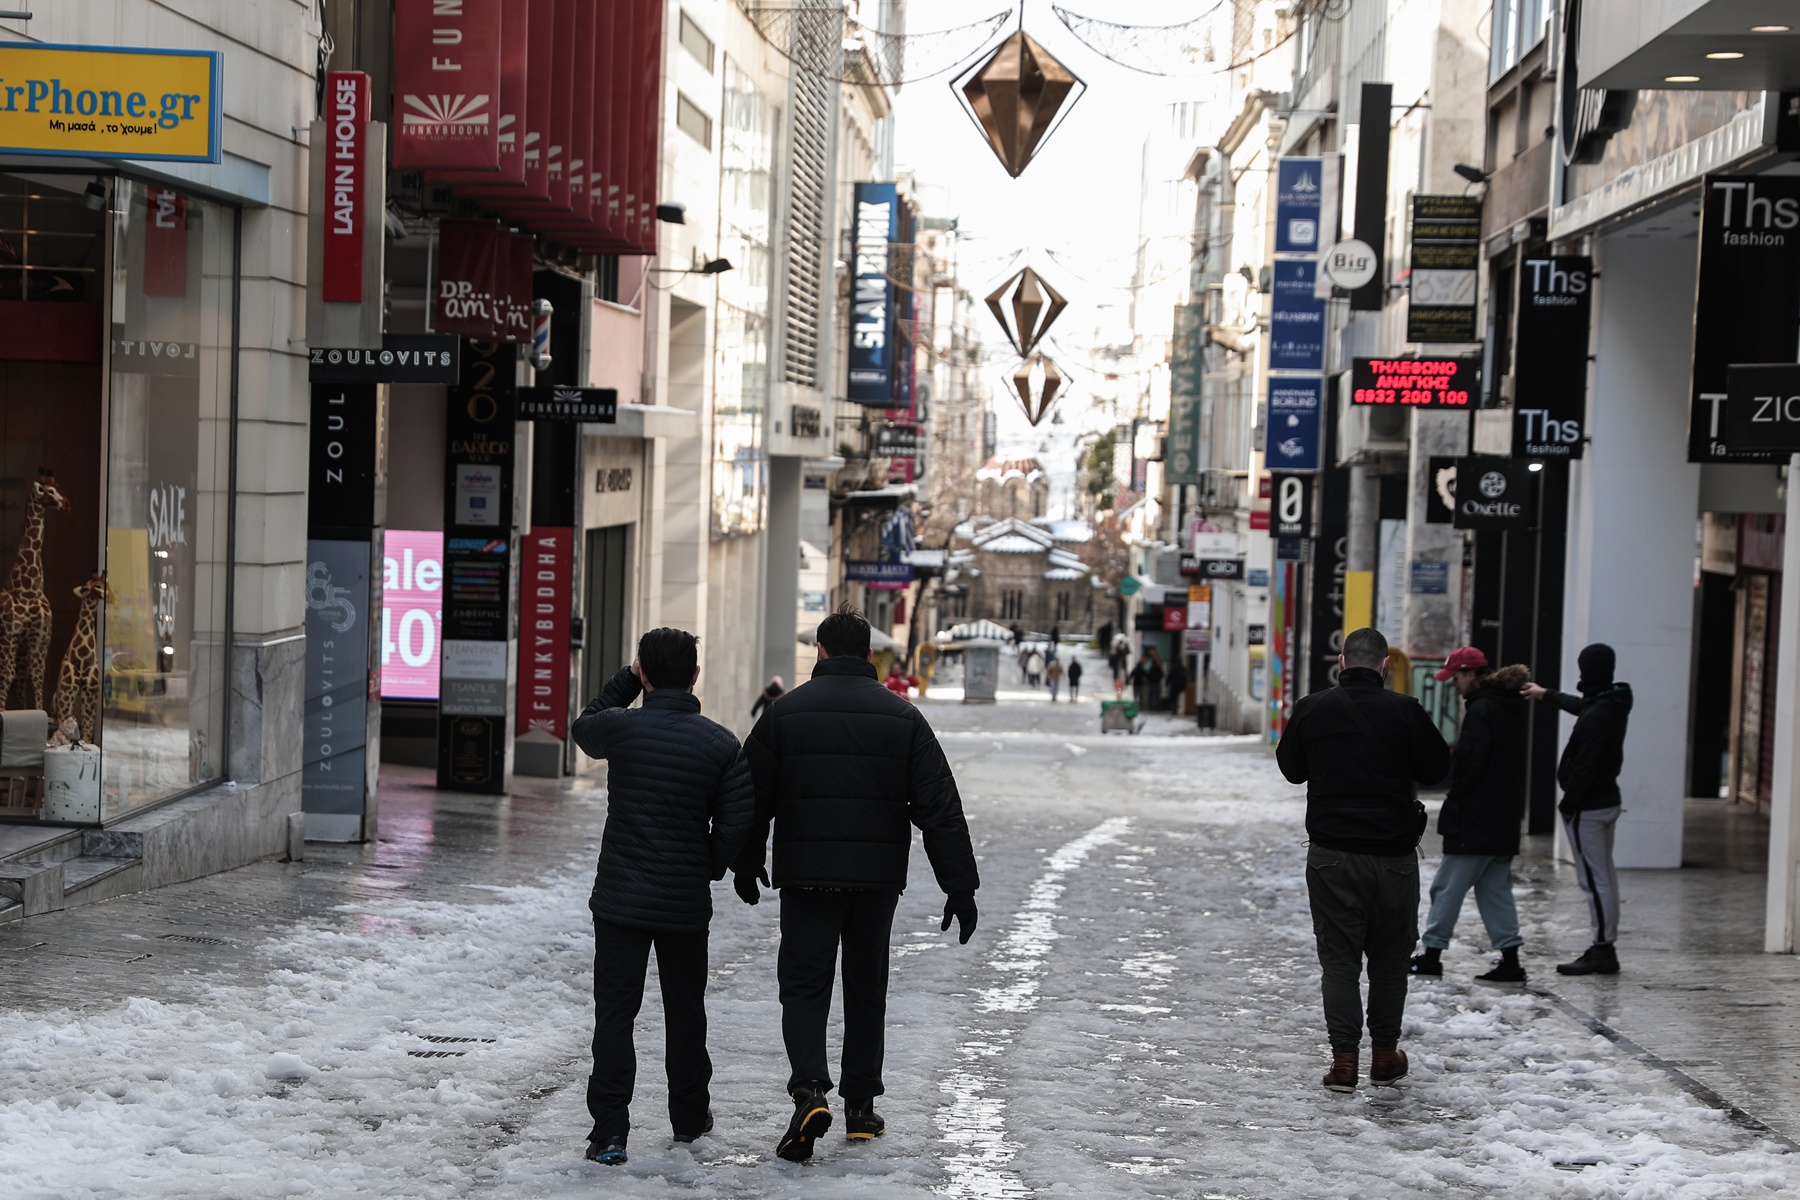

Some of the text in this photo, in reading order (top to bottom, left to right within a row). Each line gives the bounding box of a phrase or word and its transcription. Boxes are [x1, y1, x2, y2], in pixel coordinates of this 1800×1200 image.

[49, 120, 65, 131] Μη
[402, 124, 489, 135] FUNKYBUDDHA
[334, 79, 356, 234] LAPIN HOUSE
[1712, 182, 1798, 229] Ths
[1723, 231, 1784, 246] fashion
[1335, 253, 1371, 272] Big
[1526, 260, 1587, 294] Ths
[1534, 294, 1577, 306] fashion
[311, 350, 451, 365] ZOULOVITS
[1400, 390, 1432, 404] 200
[1437, 390, 1468, 405] 100
[521, 402, 614, 415] FUNKYBUDDHA
[1518, 409, 1580, 444] Ths
[1527, 443, 1570, 455] fashion
[149, 482, 186, 548] SALE
[533, 537, 557, 710] FUNKYBUDDHA
[320, 641, 334, 771] ZOULOVITS
